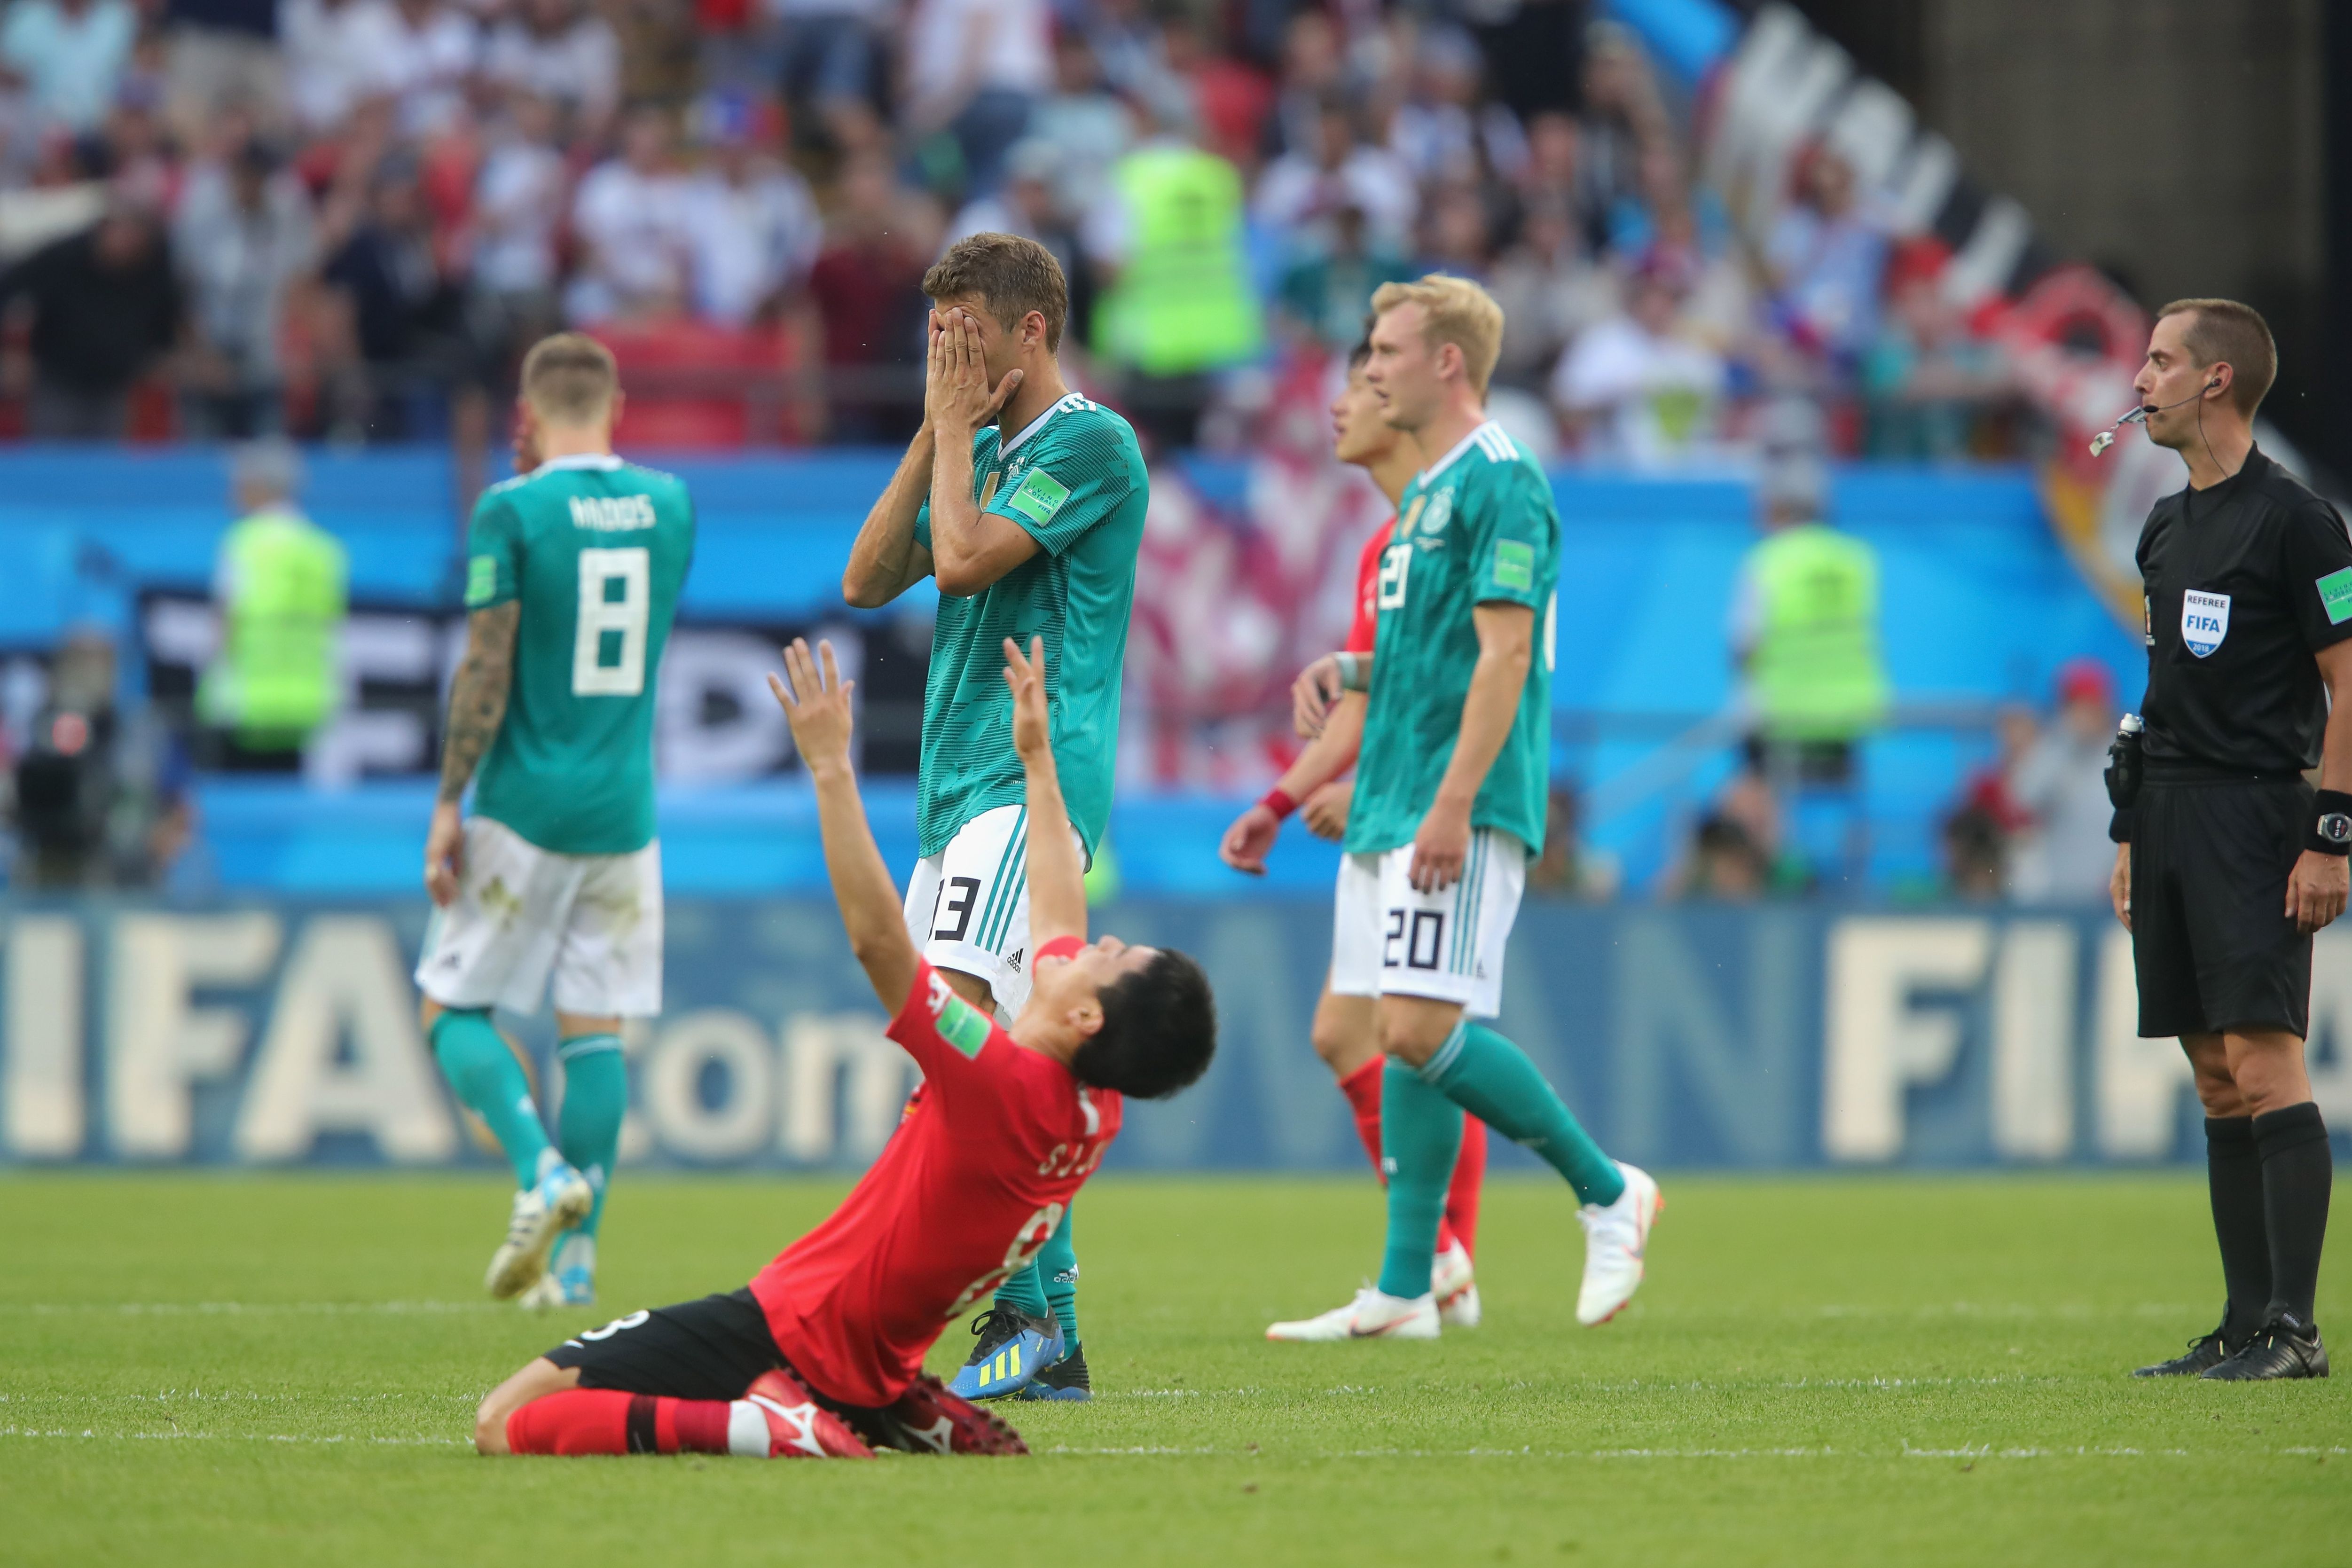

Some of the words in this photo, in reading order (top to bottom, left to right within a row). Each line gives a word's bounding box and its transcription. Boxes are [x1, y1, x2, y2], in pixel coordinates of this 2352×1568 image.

[1027, 481, 1058, 504] LIVING
[1038, 504, 1051, 515] FIFA
[2187, 595, 2226, 608] REFEREE
[572, 547, 651, 697] 8
[2187, 614, 2220, 632] FIFA
[2192, 643, 2209, 652] 2018
[1384, 909, 1444, 970] 20
[1007, 956, 1021, 973] adidas
